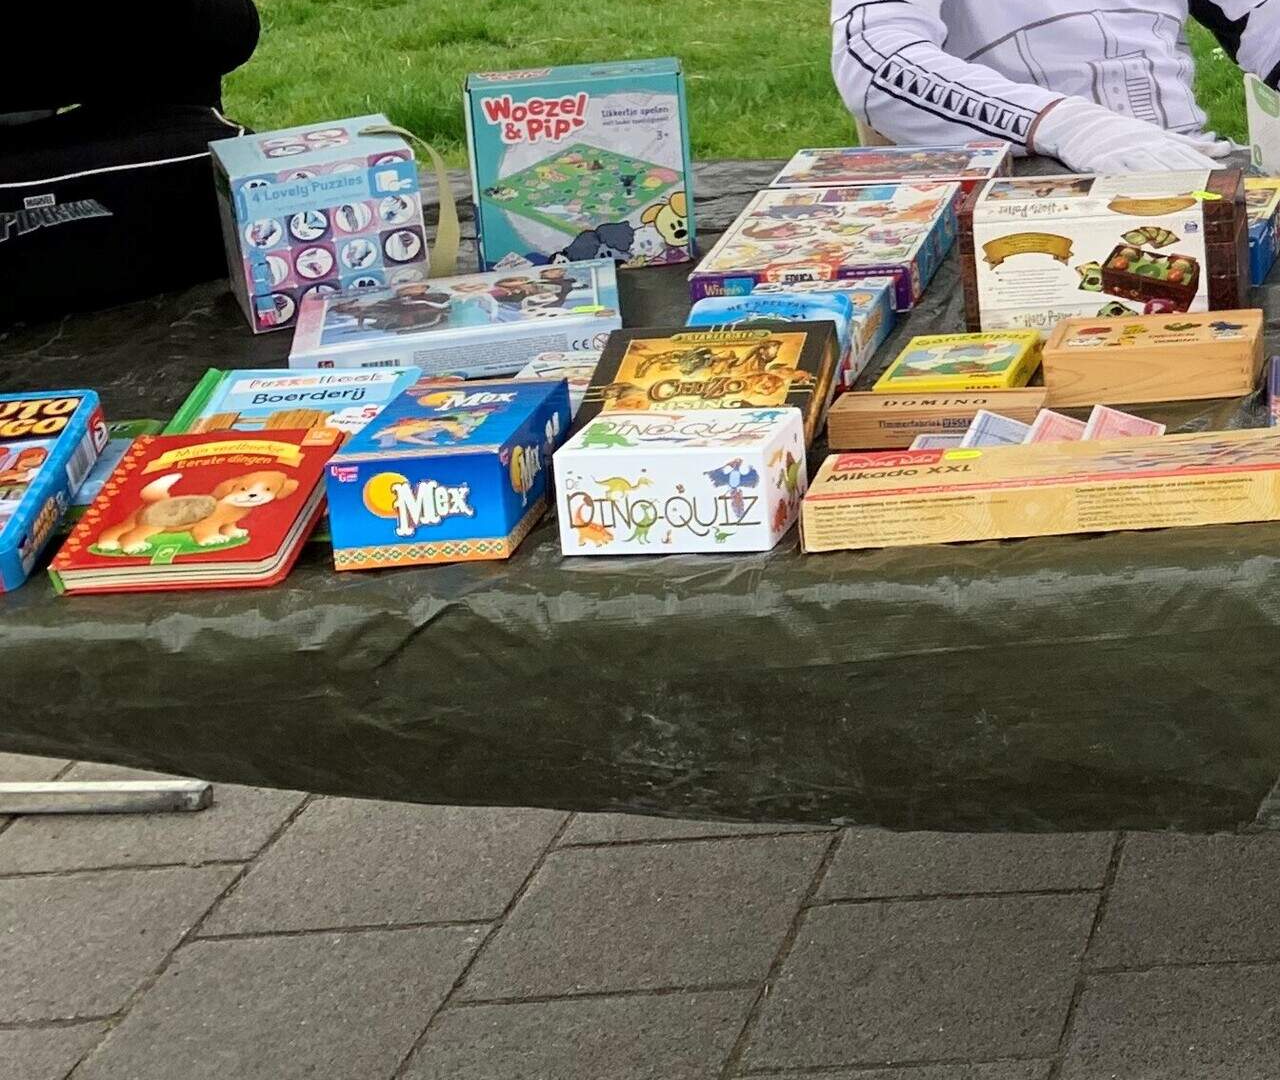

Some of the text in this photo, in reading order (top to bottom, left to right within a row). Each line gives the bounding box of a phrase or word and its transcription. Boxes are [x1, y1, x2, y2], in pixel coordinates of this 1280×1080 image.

[484, 93, 587, 122] Woezel
[504, 119, 570, 141] & Pip
[251, 175, 364, 203] 4 Lovely Puzzles
[0, 199, 113, 242] PIDER-MAN
[785, 272, 814, 283] EDUCA
[252, 387, 366, 405] Boerderij
[434, 390, 519, 411] Mex
[881, 397, 988, 408] DOMINO
[0, 397, 81, 419] UTO
[360, 407, 379, 419] 5
[177, 454, 273, 469] Eerste dingen
[825, 463, 972, 483] Mikado XXL
[391, 478, 475, 537] Mex
[567, 491, 762, 537] DINO-QUIZ
